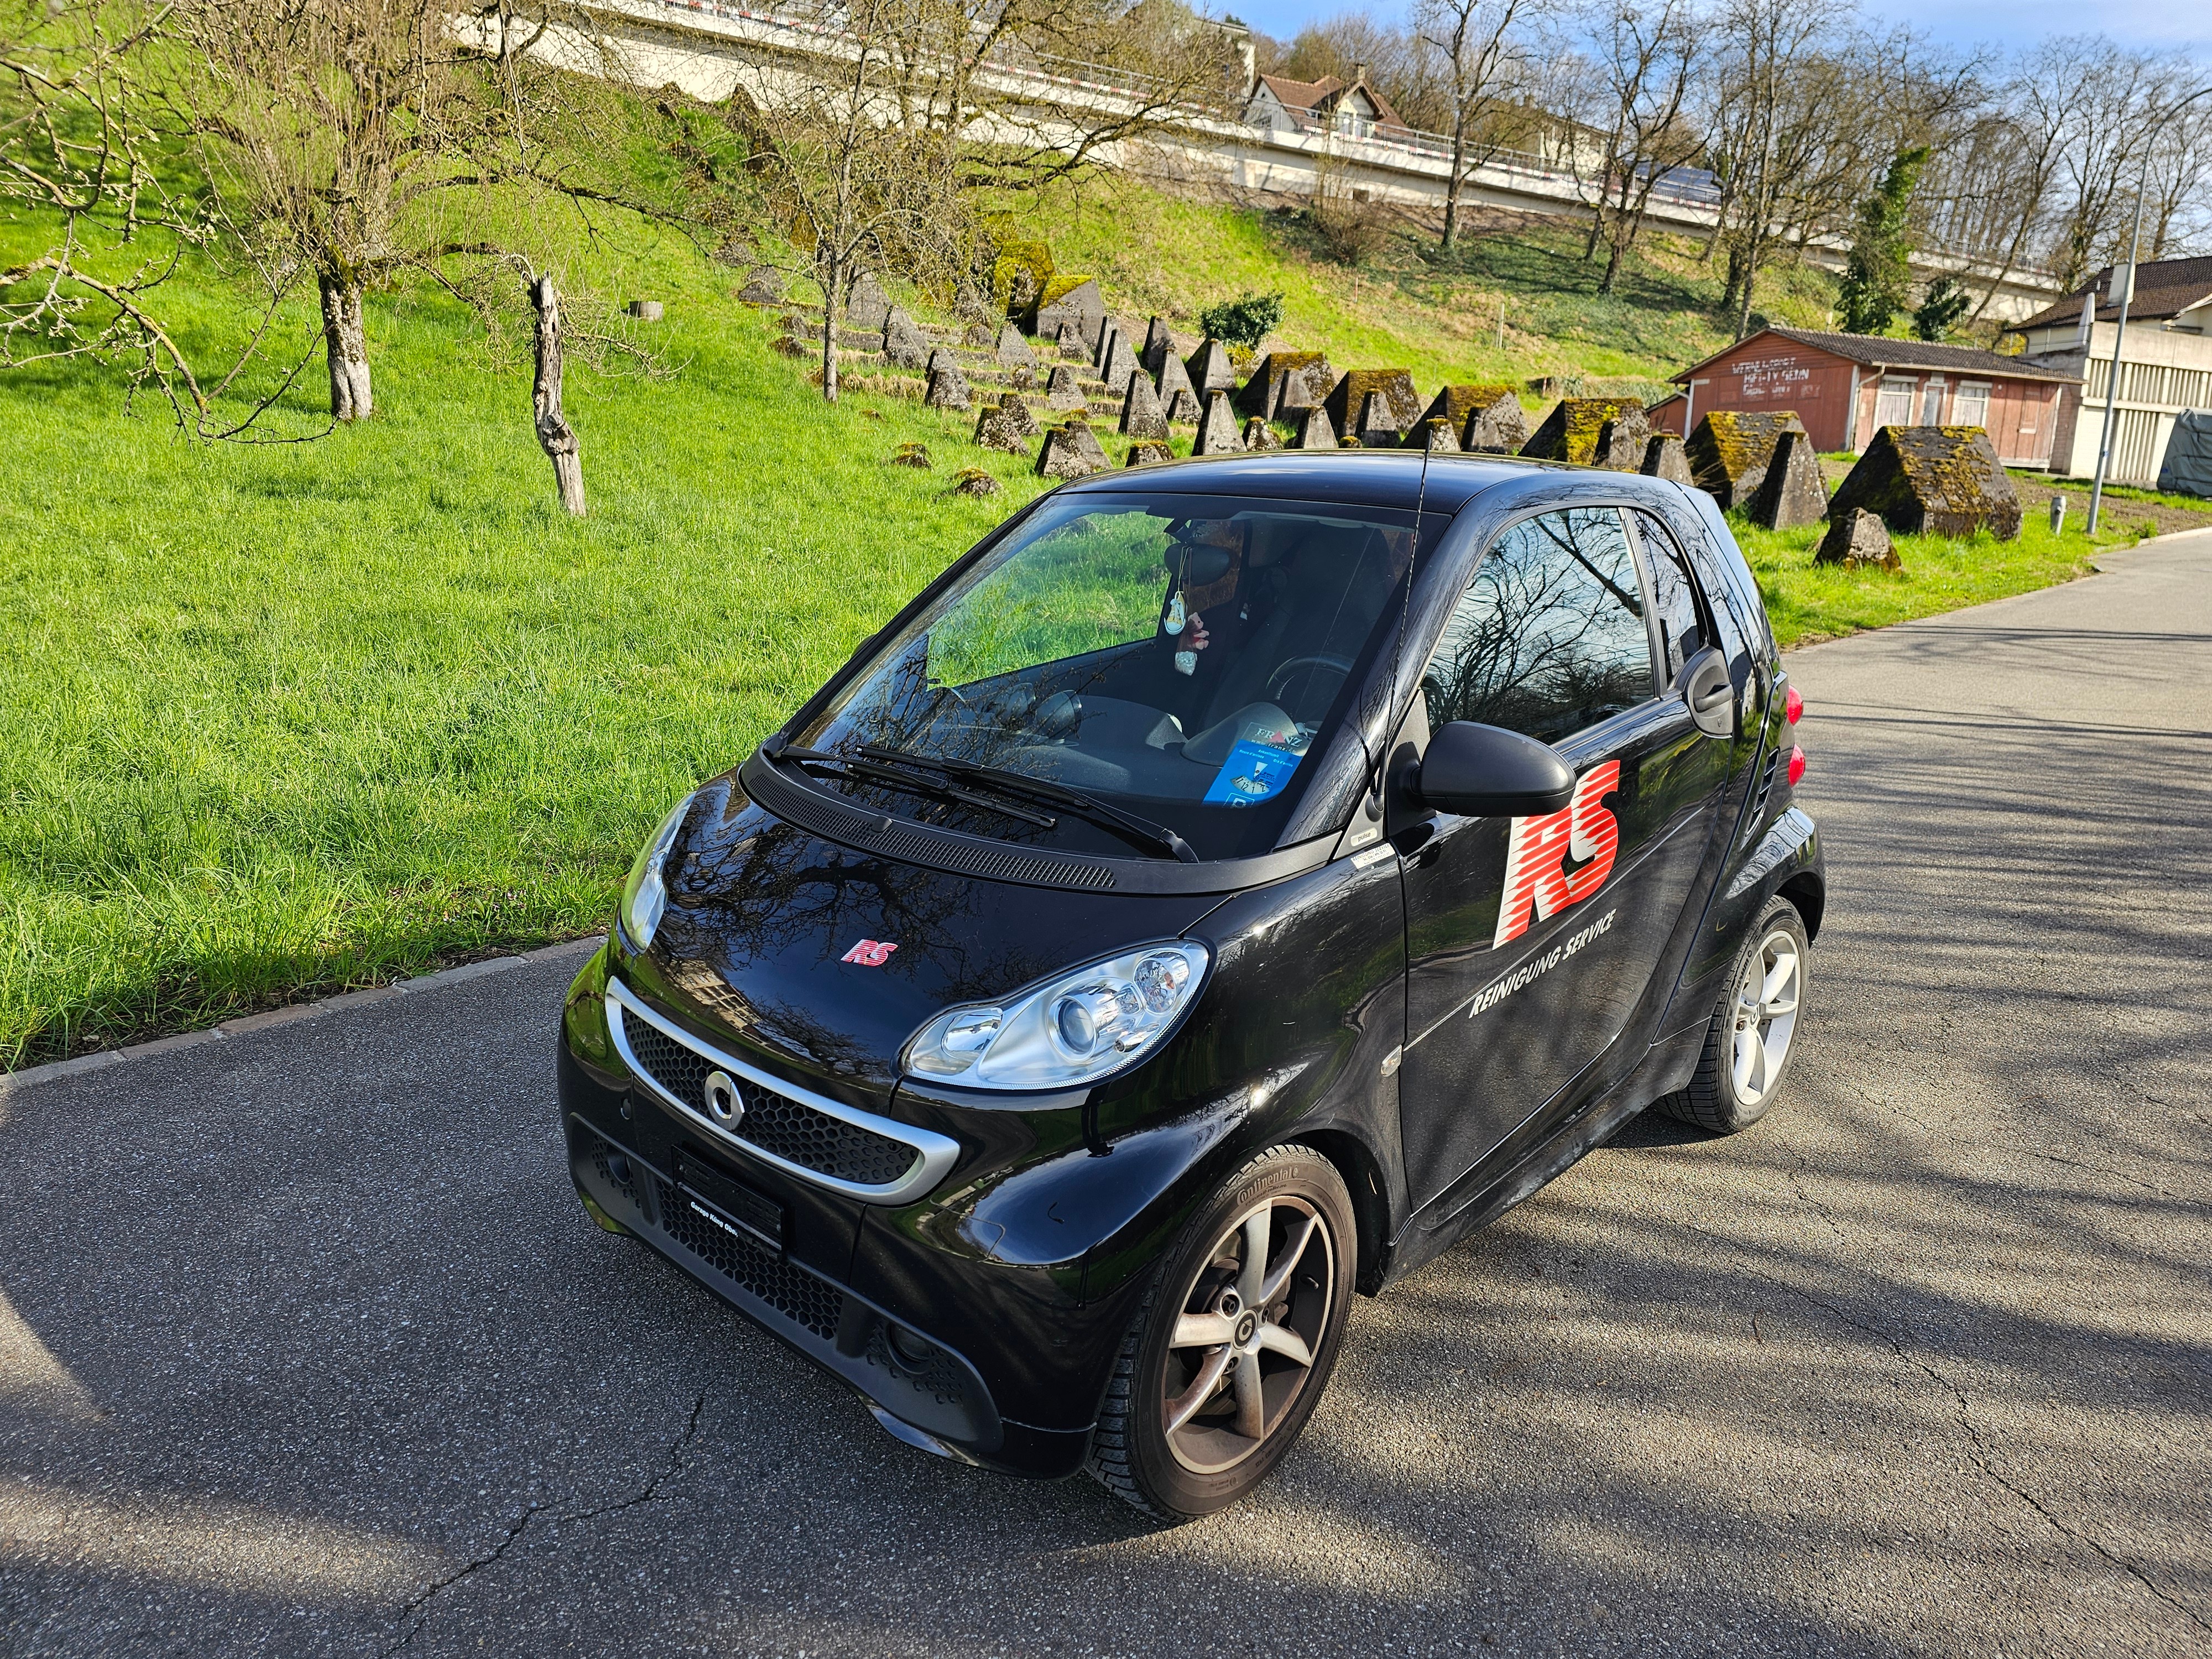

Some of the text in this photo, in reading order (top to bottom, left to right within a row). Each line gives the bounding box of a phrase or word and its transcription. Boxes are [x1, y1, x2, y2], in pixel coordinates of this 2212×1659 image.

[1240, 782, 1249, 791] 12
[1358, 832, 1371, 842] pulse
[1493, 759, 1620, 951] RS
[841, 938, 899, 967] RS
[1468, 909, 1617, 1019] REINIGUNG SERVICE
[1732, 958, 1749, 999] Barum
[1237, 1166, 1292, 1205] Continental
[691, 1201, 709, 1218] Garage
